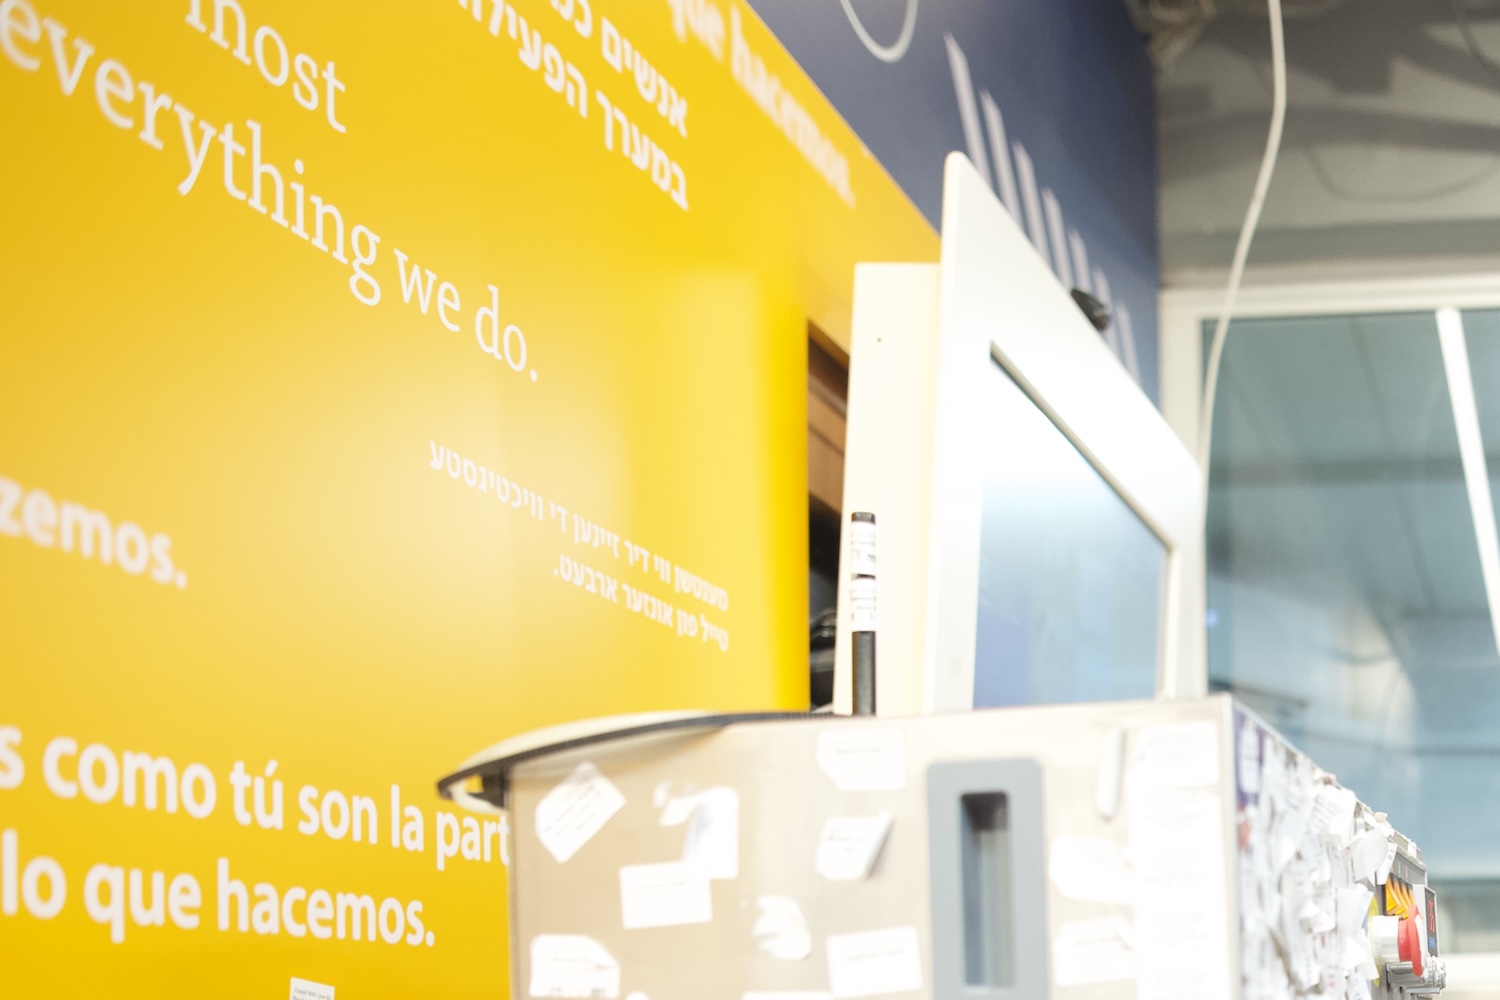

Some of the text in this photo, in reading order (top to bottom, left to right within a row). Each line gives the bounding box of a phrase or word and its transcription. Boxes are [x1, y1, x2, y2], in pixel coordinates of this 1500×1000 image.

[185, 0, 347, 133] most
[601, 15, 688, 139] אנשים
[0, 0, 538, 382] everything we do.
[595, 89, 689, 212] במערך
[549, 501, 568, 532] די
[42, 735, 217, 820] como
[229, 759, 283, 830] tú
[298, 784, 378, 846] son
[391, 784, 424, 852] la
[1, 828, 436, 948] lo que hacemos.
